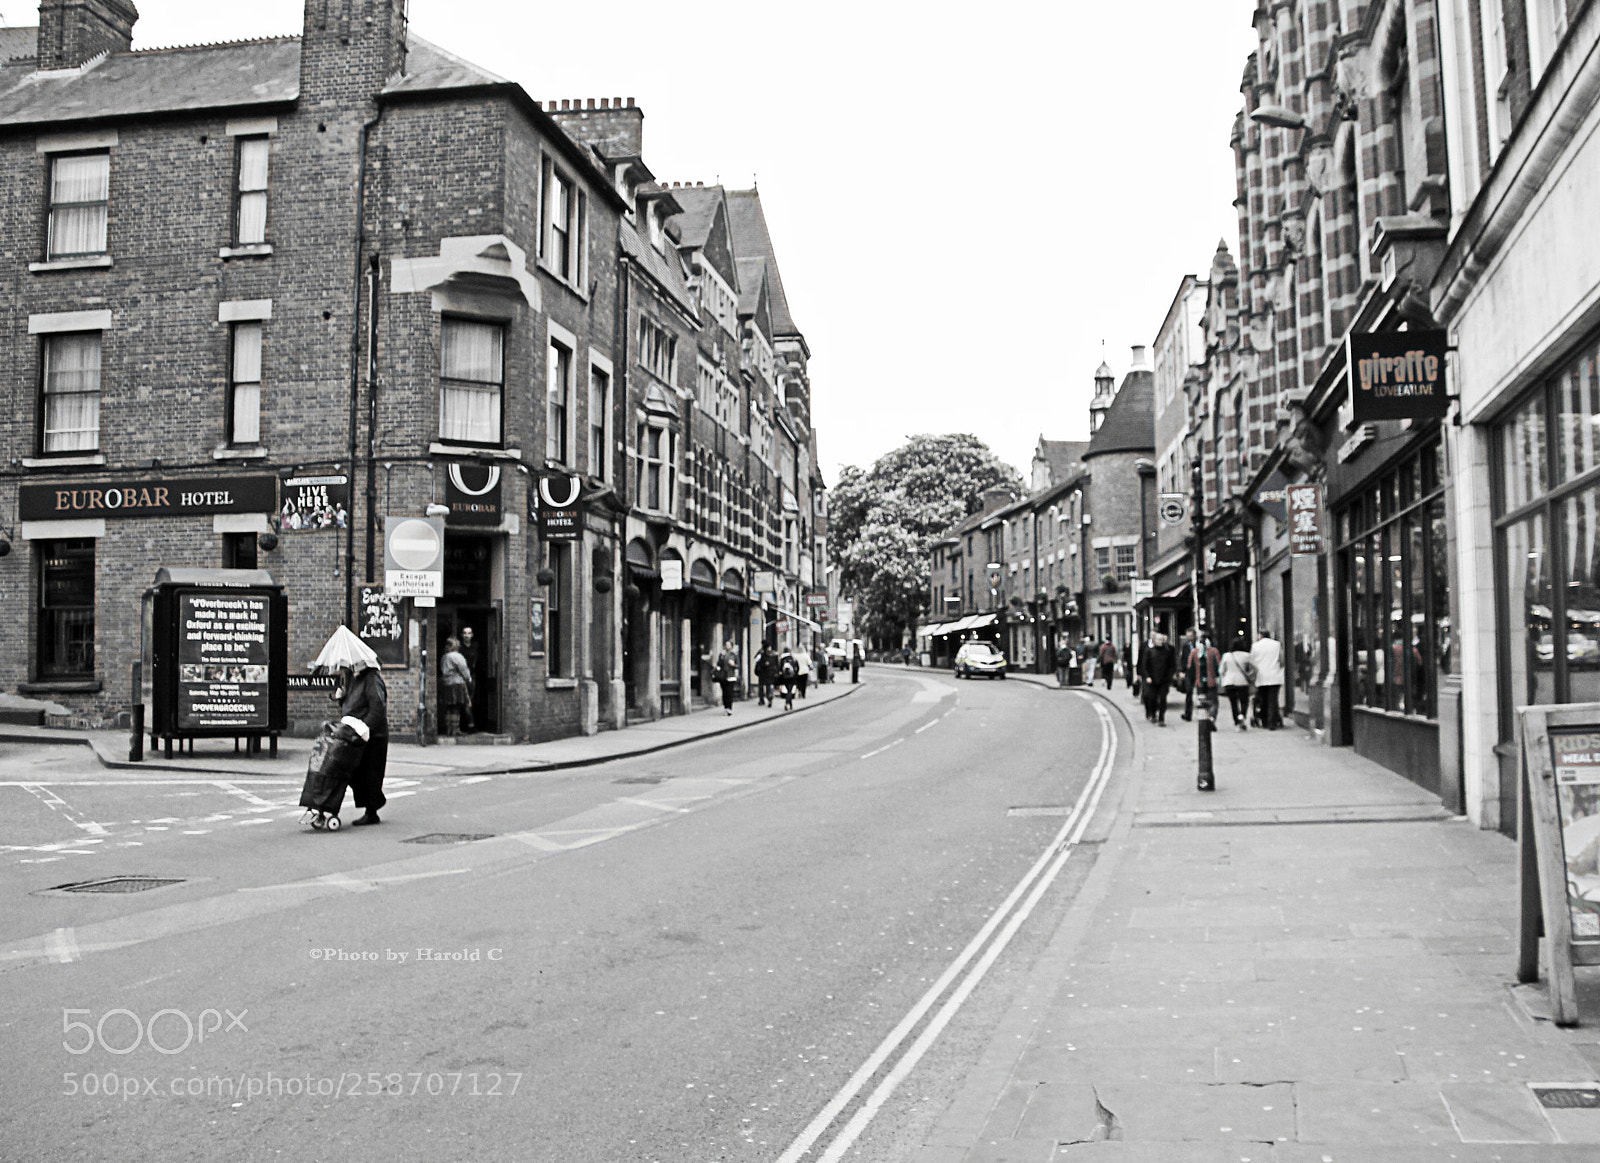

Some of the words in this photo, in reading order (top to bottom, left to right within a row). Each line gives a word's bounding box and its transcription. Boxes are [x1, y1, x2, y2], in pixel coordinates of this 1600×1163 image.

[1358, 349, 1438, 390] giraffe
[299, 485, 327, 497] LIVE
[55, 487, 170, 510] EUROBAR
[181, 491, 234, 506] HOTEL
[297, 495, 329, 507] HERE
[452, 502, 496, 512] EUROBAR
[542, 511, 577, 519] EUROBAR
[547, 518, 574, 527] HOTEL
[249, 601, 263, 610] has
[195, 610, 216, 619] made
[217, 610, 227, 619] its
[229, 610, 248, 620] mark
[250, 611, 258, 620] in
[186, 620, 212, 629] Oxford
[213, 622, 223, 630] as
[224, 622, 234, 630] an
[236, 621, 265, 632] exciting
[187, 631, 201, 640] and
[201, 642, 222, 652] place
[224, 642, 232, 652] to
[287, 677, 308, 687] HAIN
[311, 677, 336, 687] ALLEY
[1562, 752, 1592, 763] MEAL
